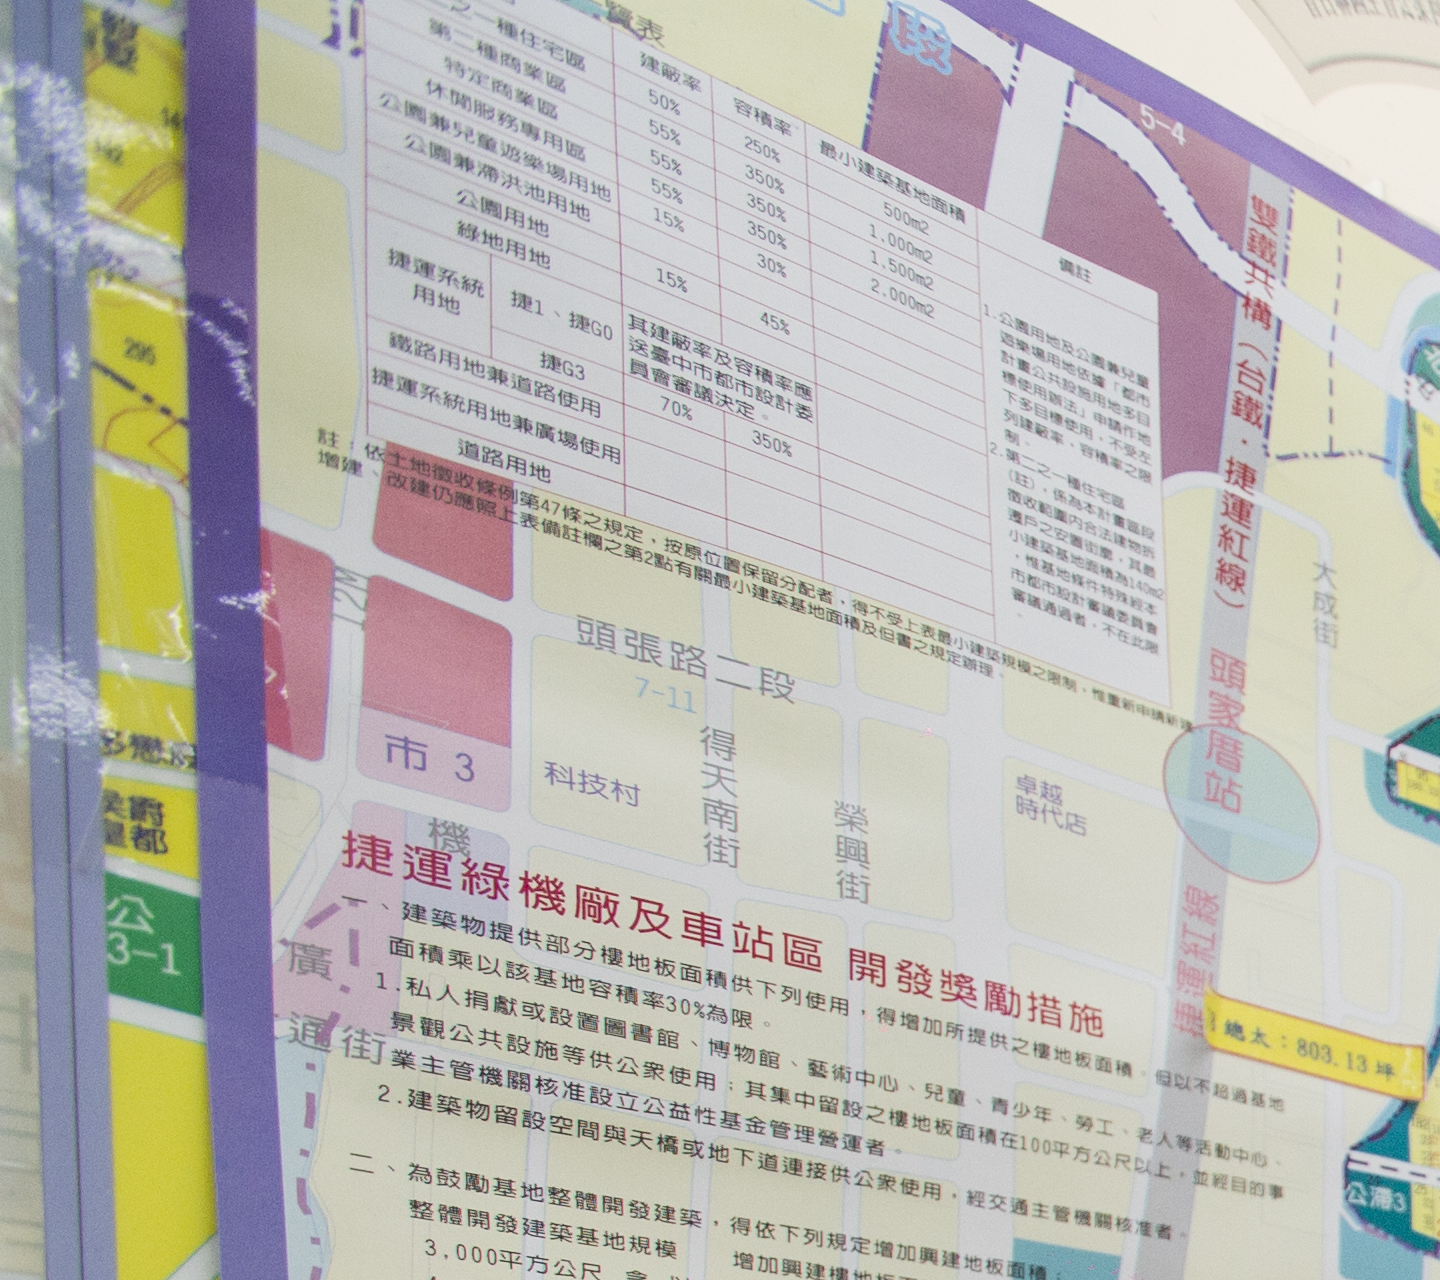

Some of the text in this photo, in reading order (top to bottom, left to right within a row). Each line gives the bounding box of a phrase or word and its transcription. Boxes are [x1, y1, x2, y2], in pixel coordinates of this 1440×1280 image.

[444, 56, 558, 121] 特定商業區
[640, 51, 702, 92] 建蔽率
[647, 89, 683, 117] 50%
[733, 95, 793, 139] 容積率
[648, 119, 683, 147] 55%
[743, 134, 782, 166] 250%
[650, 148, 684, 177] 55%
[745, 164, 786, 195] 350%
[818, 138, 968, 225] 最小建築基地面積
[650, 177, 685, 204] 55%
[746, 192, 788, 224] 350%
[456, 187, 551, 241] 公園用地
[652, 203, 686, 233] 15%
[456, 219, 552, 271] 綠地用地
[747, 219, 788, 250] 350%
[387, 246, 485, 301] 捷運系統
[655, 267, 690, 294] 15%
[757, 252, 788, 279] 30%
[1059, 256, 1093, 285] 備註
[413, 288, 461, 319] 用地
[760, 310, 792, 338] 45%
[539, 350, 586, 383] 捷G3
[660, 397, 695, 422] 70%
[457, 439, 552, 484] 道路用地
[751, 428, 794, 459] 350%
[1312, 560, 1339, 649] 大成街
[575, 615, 797, 705] 頭張路二段
[634, 676, 698, 715] 7-11
[384, 734, 476, 782] 市 3
[544, 762, 641, 807] 科技村
[699, 725, 740, 868] 得天南街
[834, 799, 872, 904] 榮興街
[107, 893, 156, 934] 公
[107, 930, 182, 976] 3-1
[340, 829, 1106, 1040] 捷運綠機廠及車站區 開發獎勵措施
[408, 1198, 678, 1261] 整體開發建築基地規模
